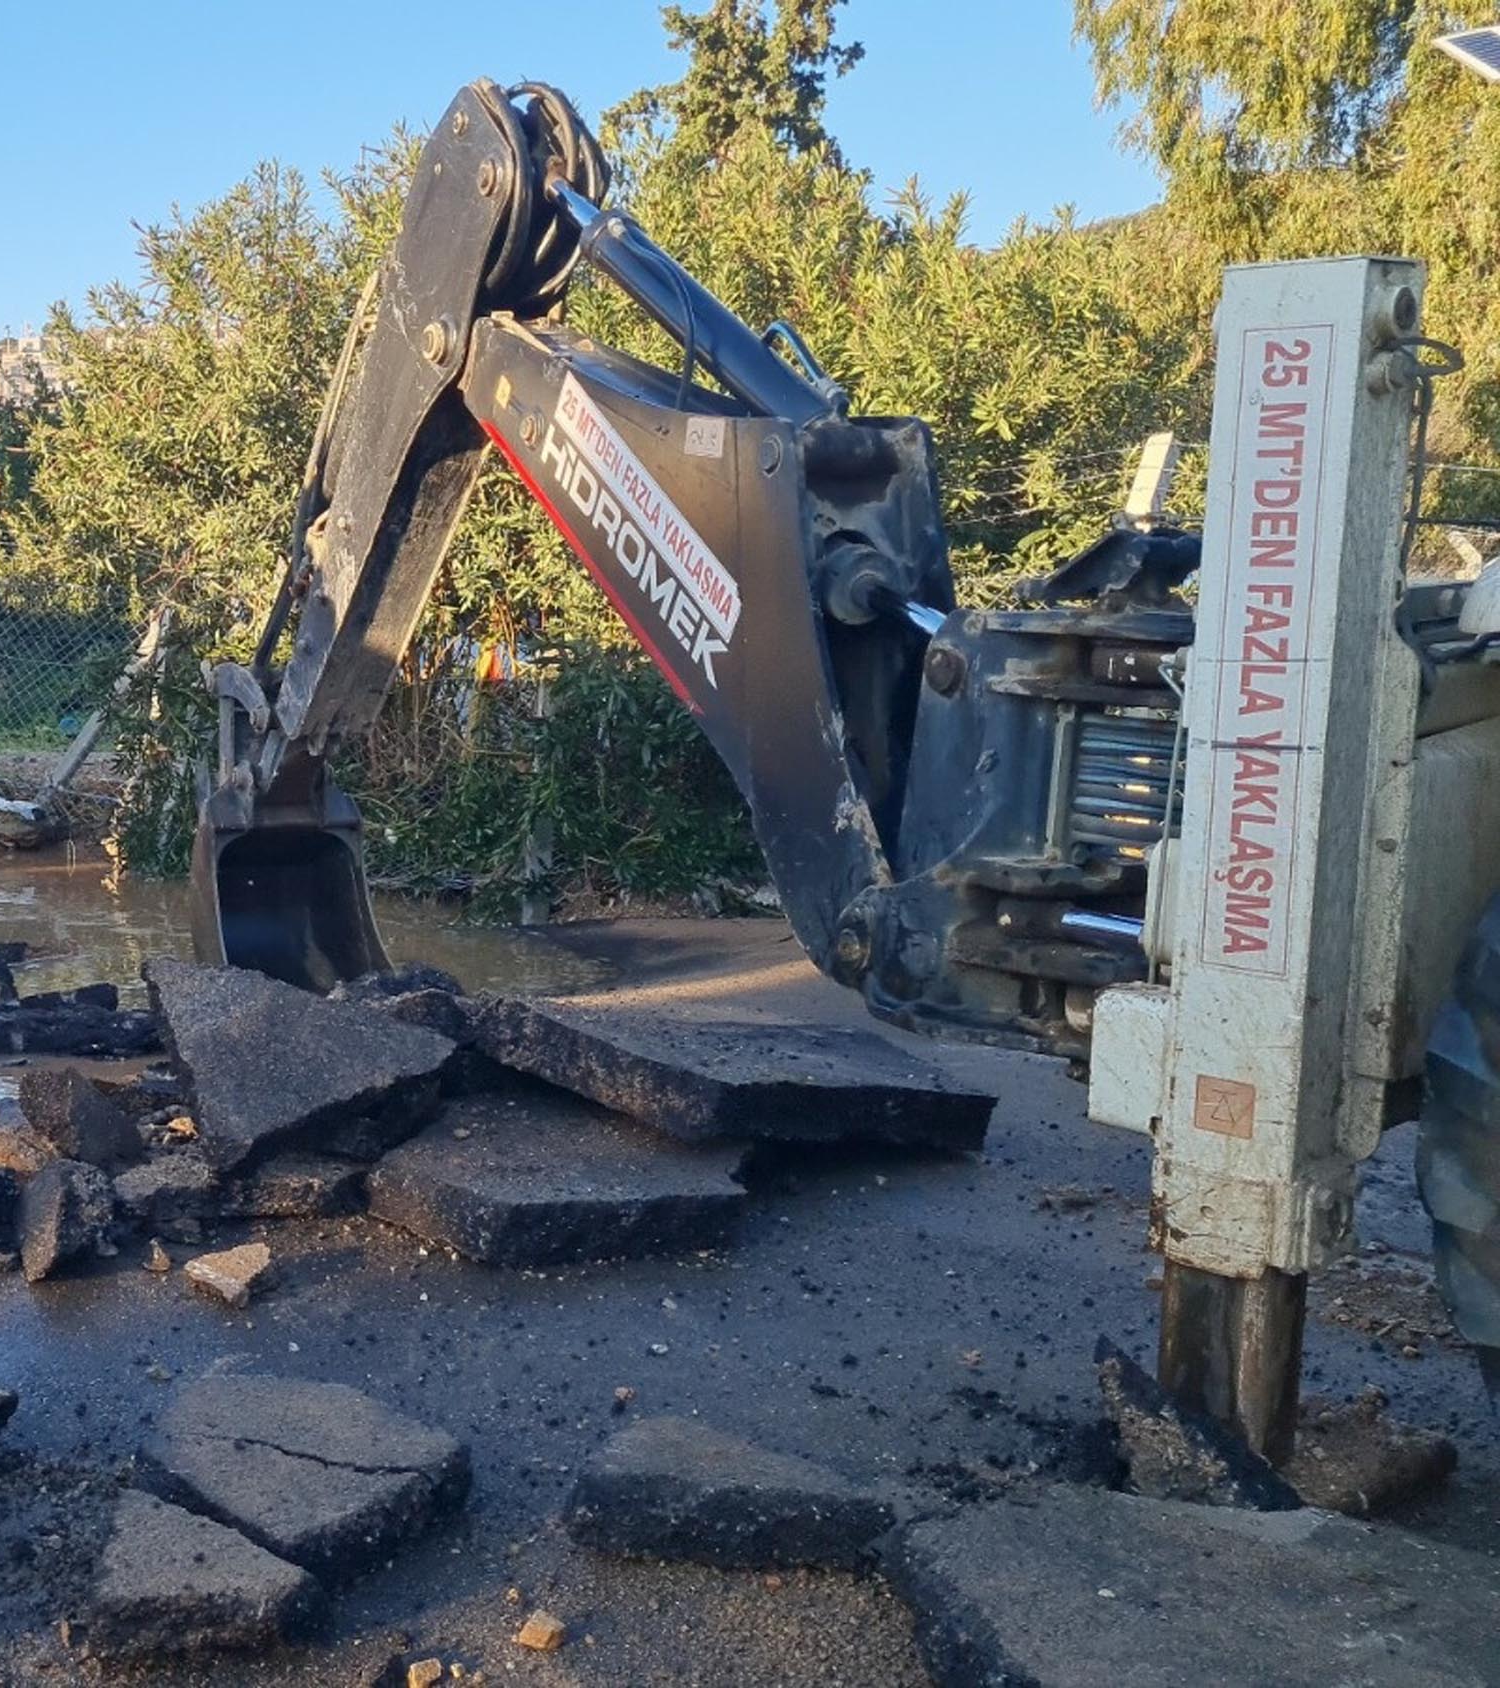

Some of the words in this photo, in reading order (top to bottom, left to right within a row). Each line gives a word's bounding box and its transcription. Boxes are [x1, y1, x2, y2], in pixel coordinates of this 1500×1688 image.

[1261, 339, 1311, 387] 25
[561, 388, 579, 419] 25
[576, 408, 622, 478] MT'DEN
[621, 463, 661, 527] FAZLA
[663, 516, 733, 622] YAKLAŞMA
[1249, 402, 1308, 568] MT'DEN
[1238, 583, 1294, 716] FAZLA
[1214, 730, 1284, 954] YAKLAŞMA
